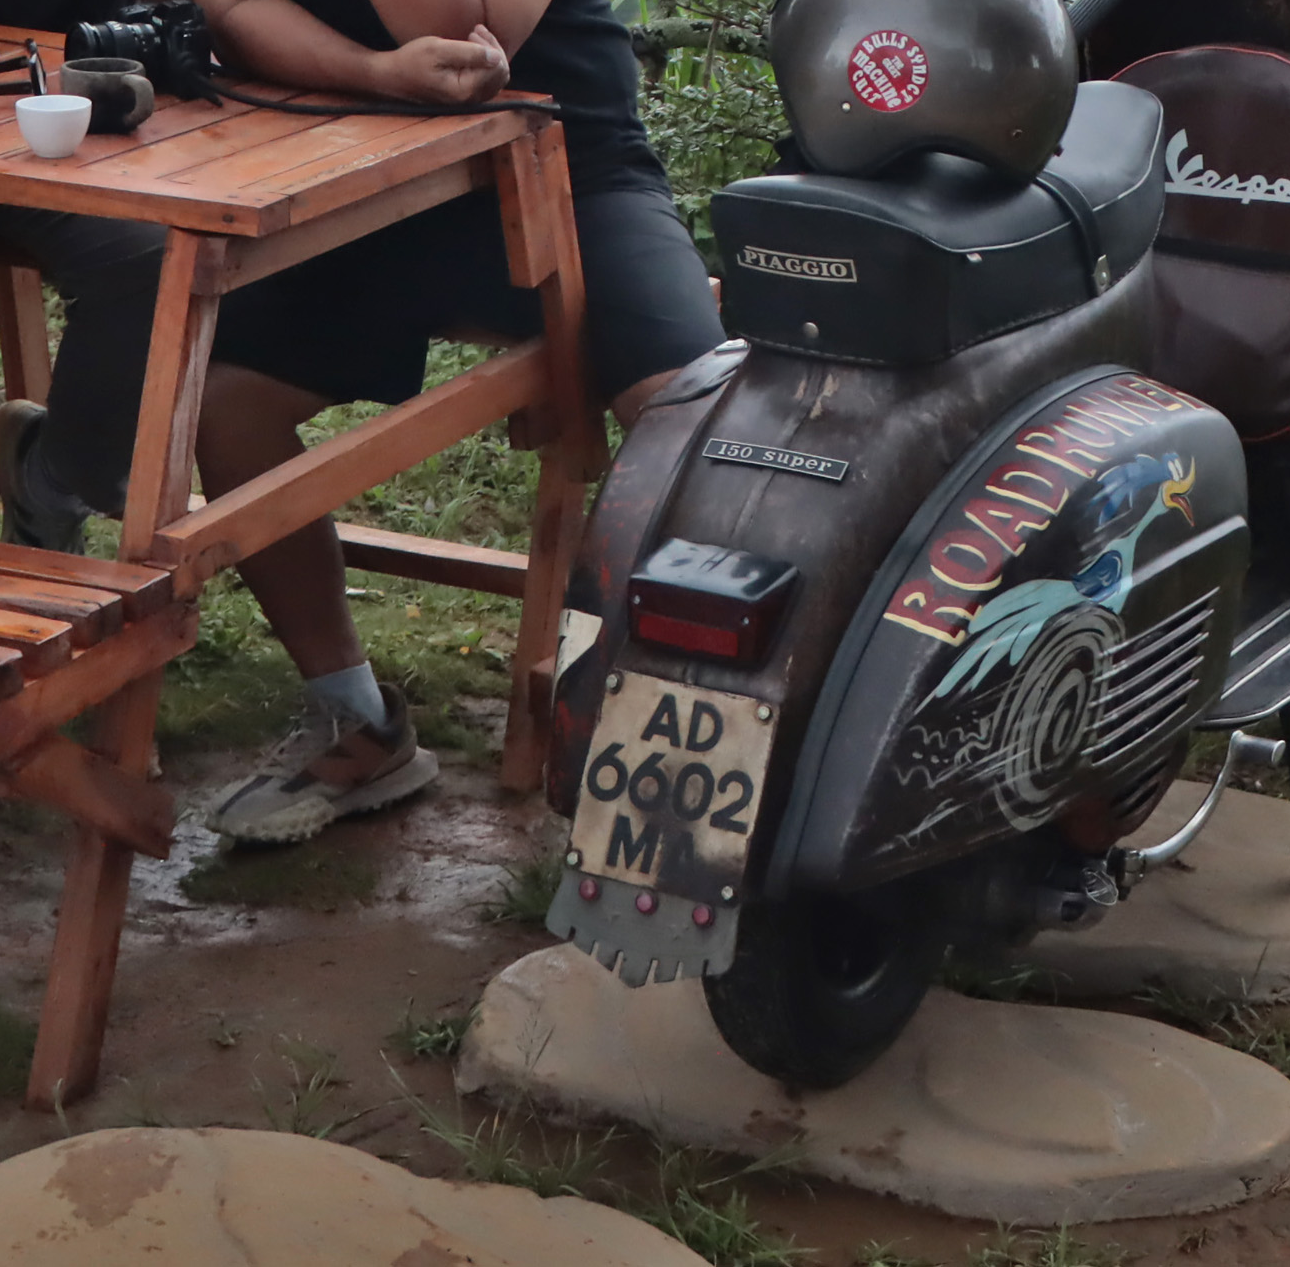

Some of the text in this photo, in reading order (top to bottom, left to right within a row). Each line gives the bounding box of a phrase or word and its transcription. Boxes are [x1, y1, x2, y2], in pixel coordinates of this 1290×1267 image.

[862, 32, 908, 54] BULLS
[852, 69, 882, 104] CULT
[743, 248, 848, 278] PIAGGIO
[717, 442, 833, 473] 150 super
[640, 692, 724, 753] AD
[586, 742, 755, 835] 6602
